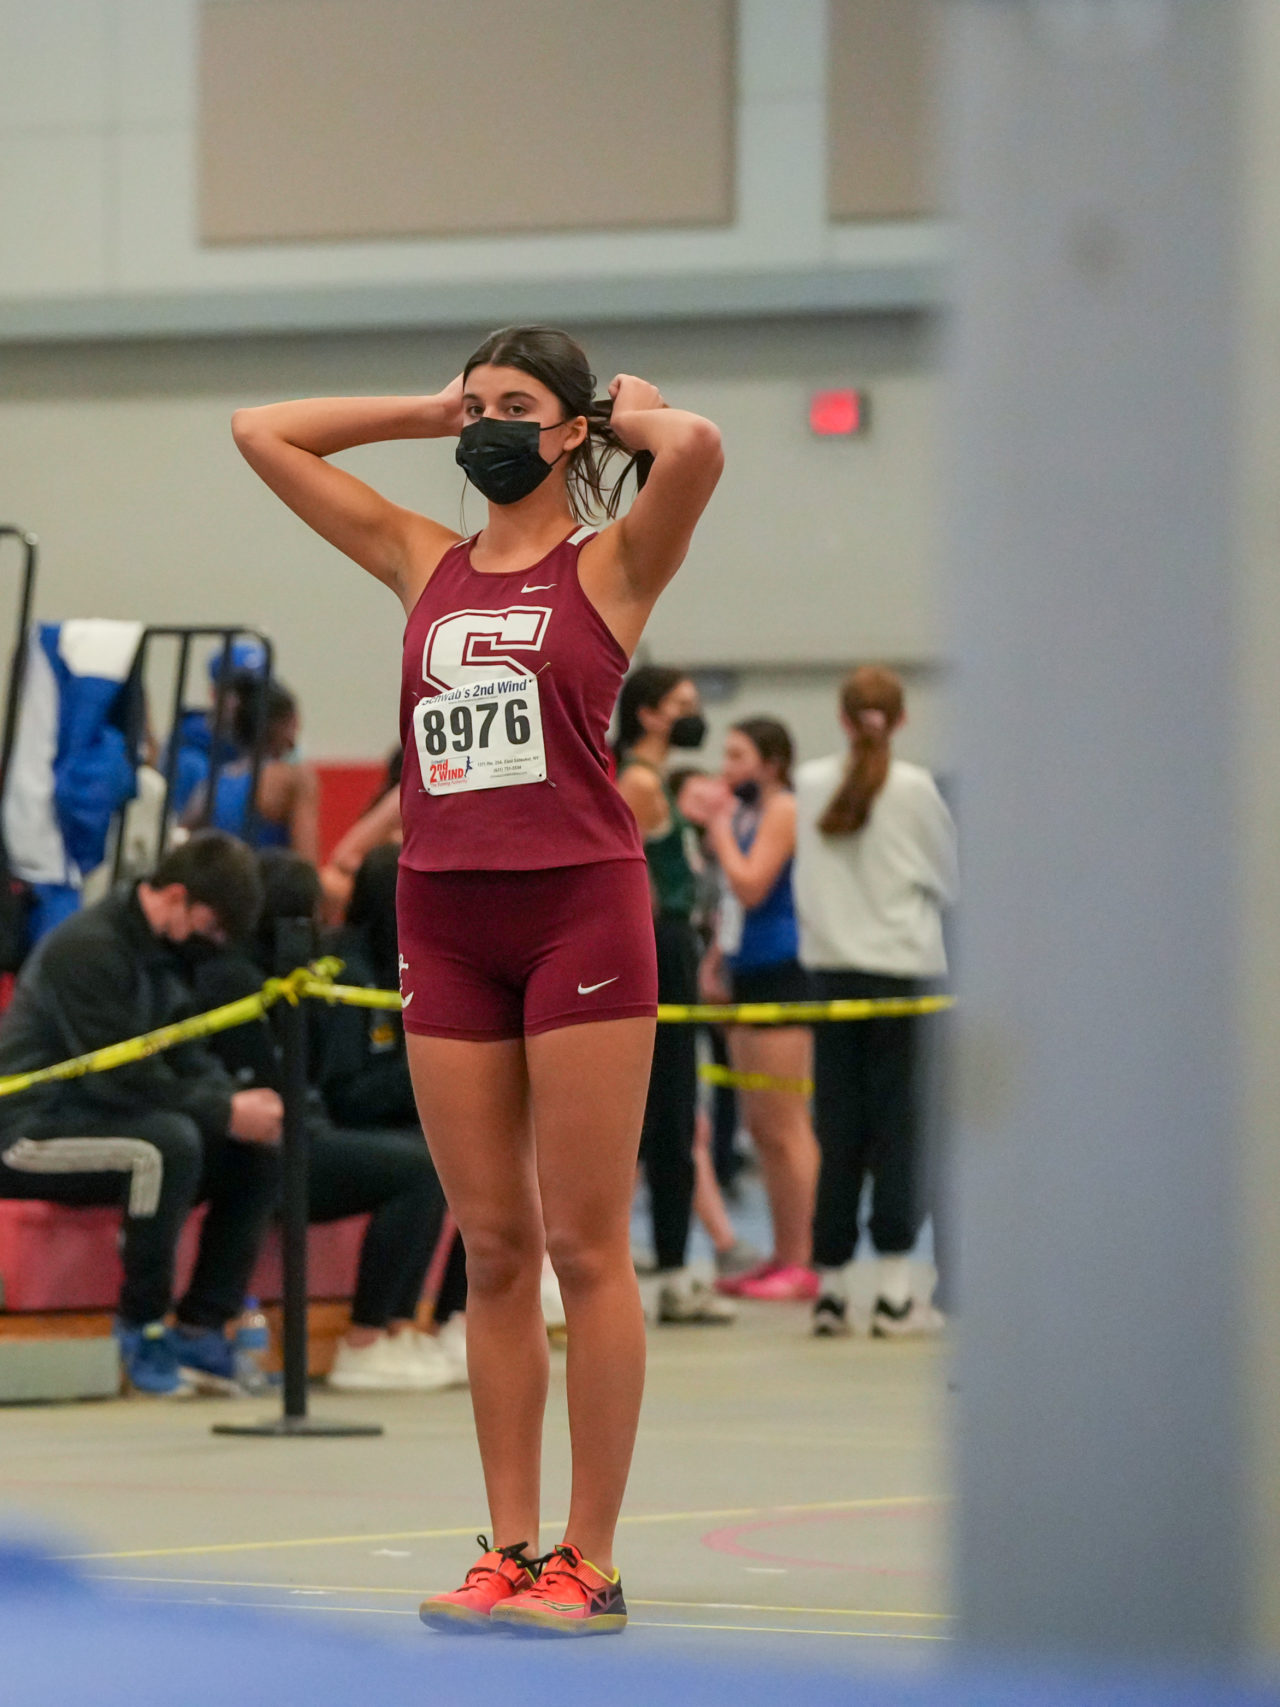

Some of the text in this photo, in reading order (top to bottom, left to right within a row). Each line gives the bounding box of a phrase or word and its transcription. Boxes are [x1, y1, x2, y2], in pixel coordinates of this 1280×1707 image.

[422, 605, 552, 692] S
[472, 683, 495, 697] 2nd
[497, 679, 527, 694] Wind
[423, 698, 531, 756] 8976
[430, 759, 449, 784] 2nd
[439, 768, 464, 782] WIND
